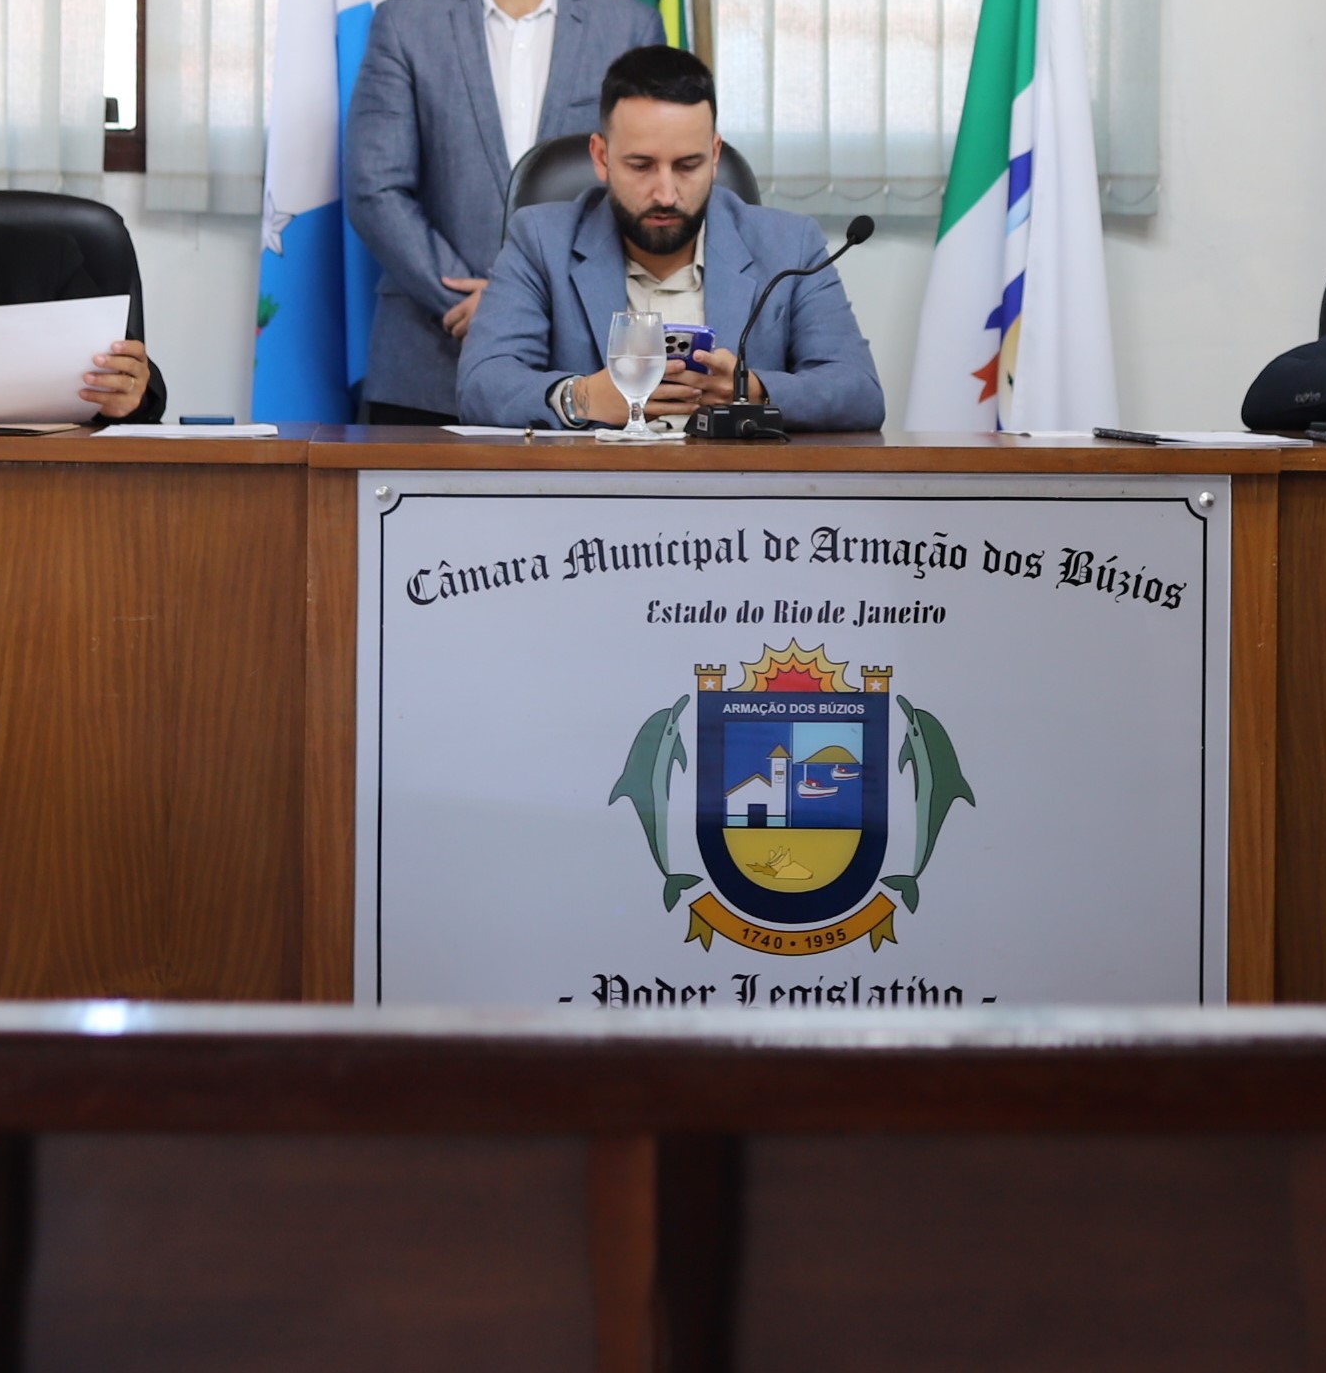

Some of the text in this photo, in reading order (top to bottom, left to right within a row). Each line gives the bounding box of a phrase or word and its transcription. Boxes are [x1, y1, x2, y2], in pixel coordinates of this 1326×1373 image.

[406, 526, 1188, 610] Câmara Municipal de Armação dos Búzios
[646, 599, 947, 628] Estado do Rio de Janeiro
[722, 701, 865, 716] ARMAÇÃO DOS BÚZIOS
[742, 927, 847, 949] 1740 1995
